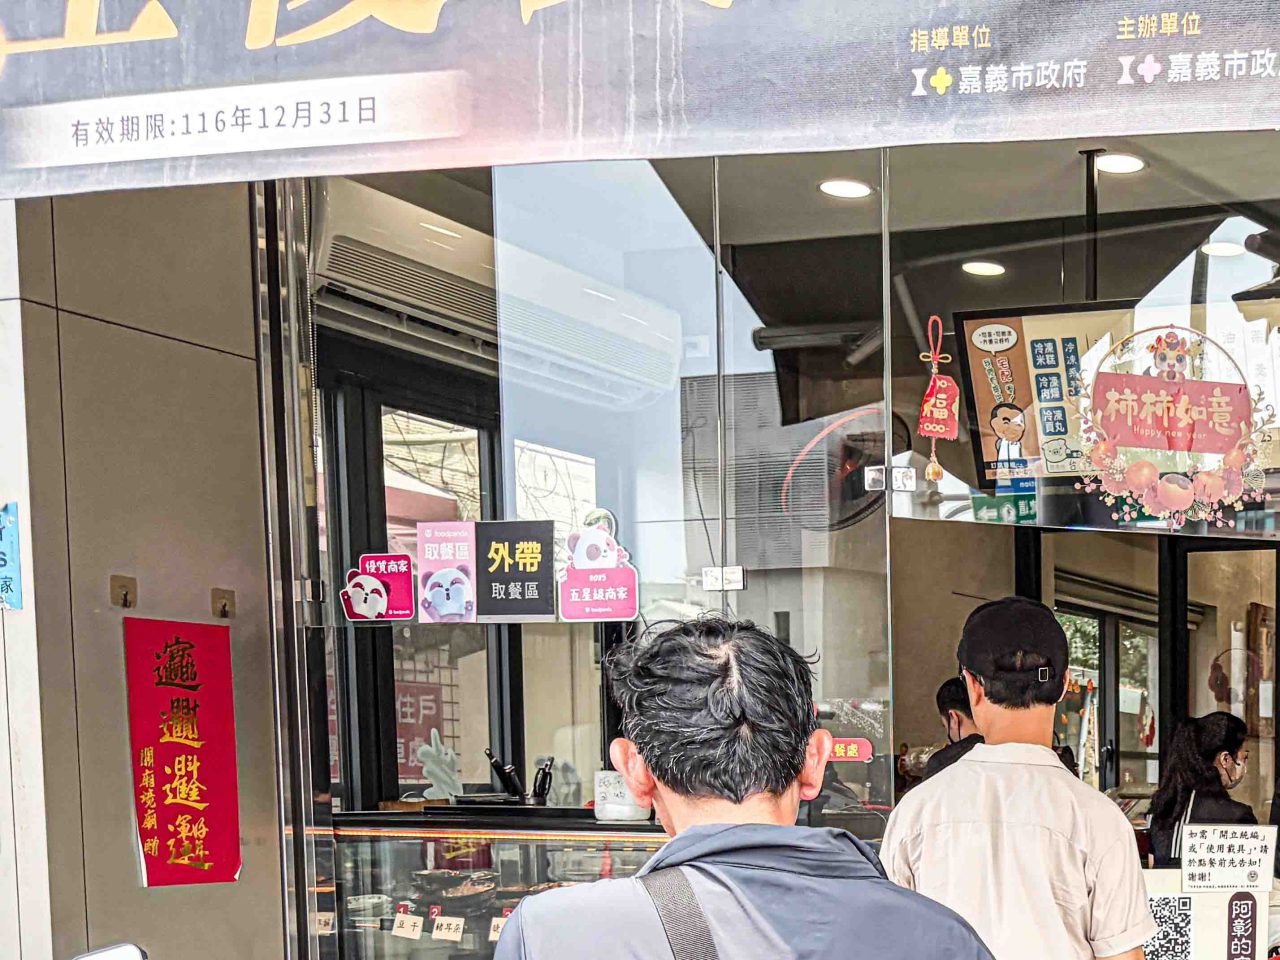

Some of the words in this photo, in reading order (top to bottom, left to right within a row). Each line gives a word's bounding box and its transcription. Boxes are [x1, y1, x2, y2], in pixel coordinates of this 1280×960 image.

[1116, 11, 1201, 40] 主辦單位
[910, 24, 991, 52] 指導單位
[958, 58, 1087, 94] 嘉義市政府
[70, 95, 380, 148] 有效期限:116年12月31日
[1104, 387, 1234, 436] 柿柿如意
[1134, 424, 1162, 438] Happy
[1165, 430, 1182, 438] new
[1187, 432, 1206, 442] year
[434, 530, 468, 538] foodpanda
[424, 542, 470, 560] 取餐區
[488, 542, 542, 573] 外帶
[365, 560, 408, 574] 優質商家
[492, 582, 539, 599] 取餐區
[570, 586, 628, 602] 五星級商家
[1188, 829, 1266, 841] 如需「開立統編」
[432, 908, 438, 918] 2
[397, 920, 420, 932] 豆干
